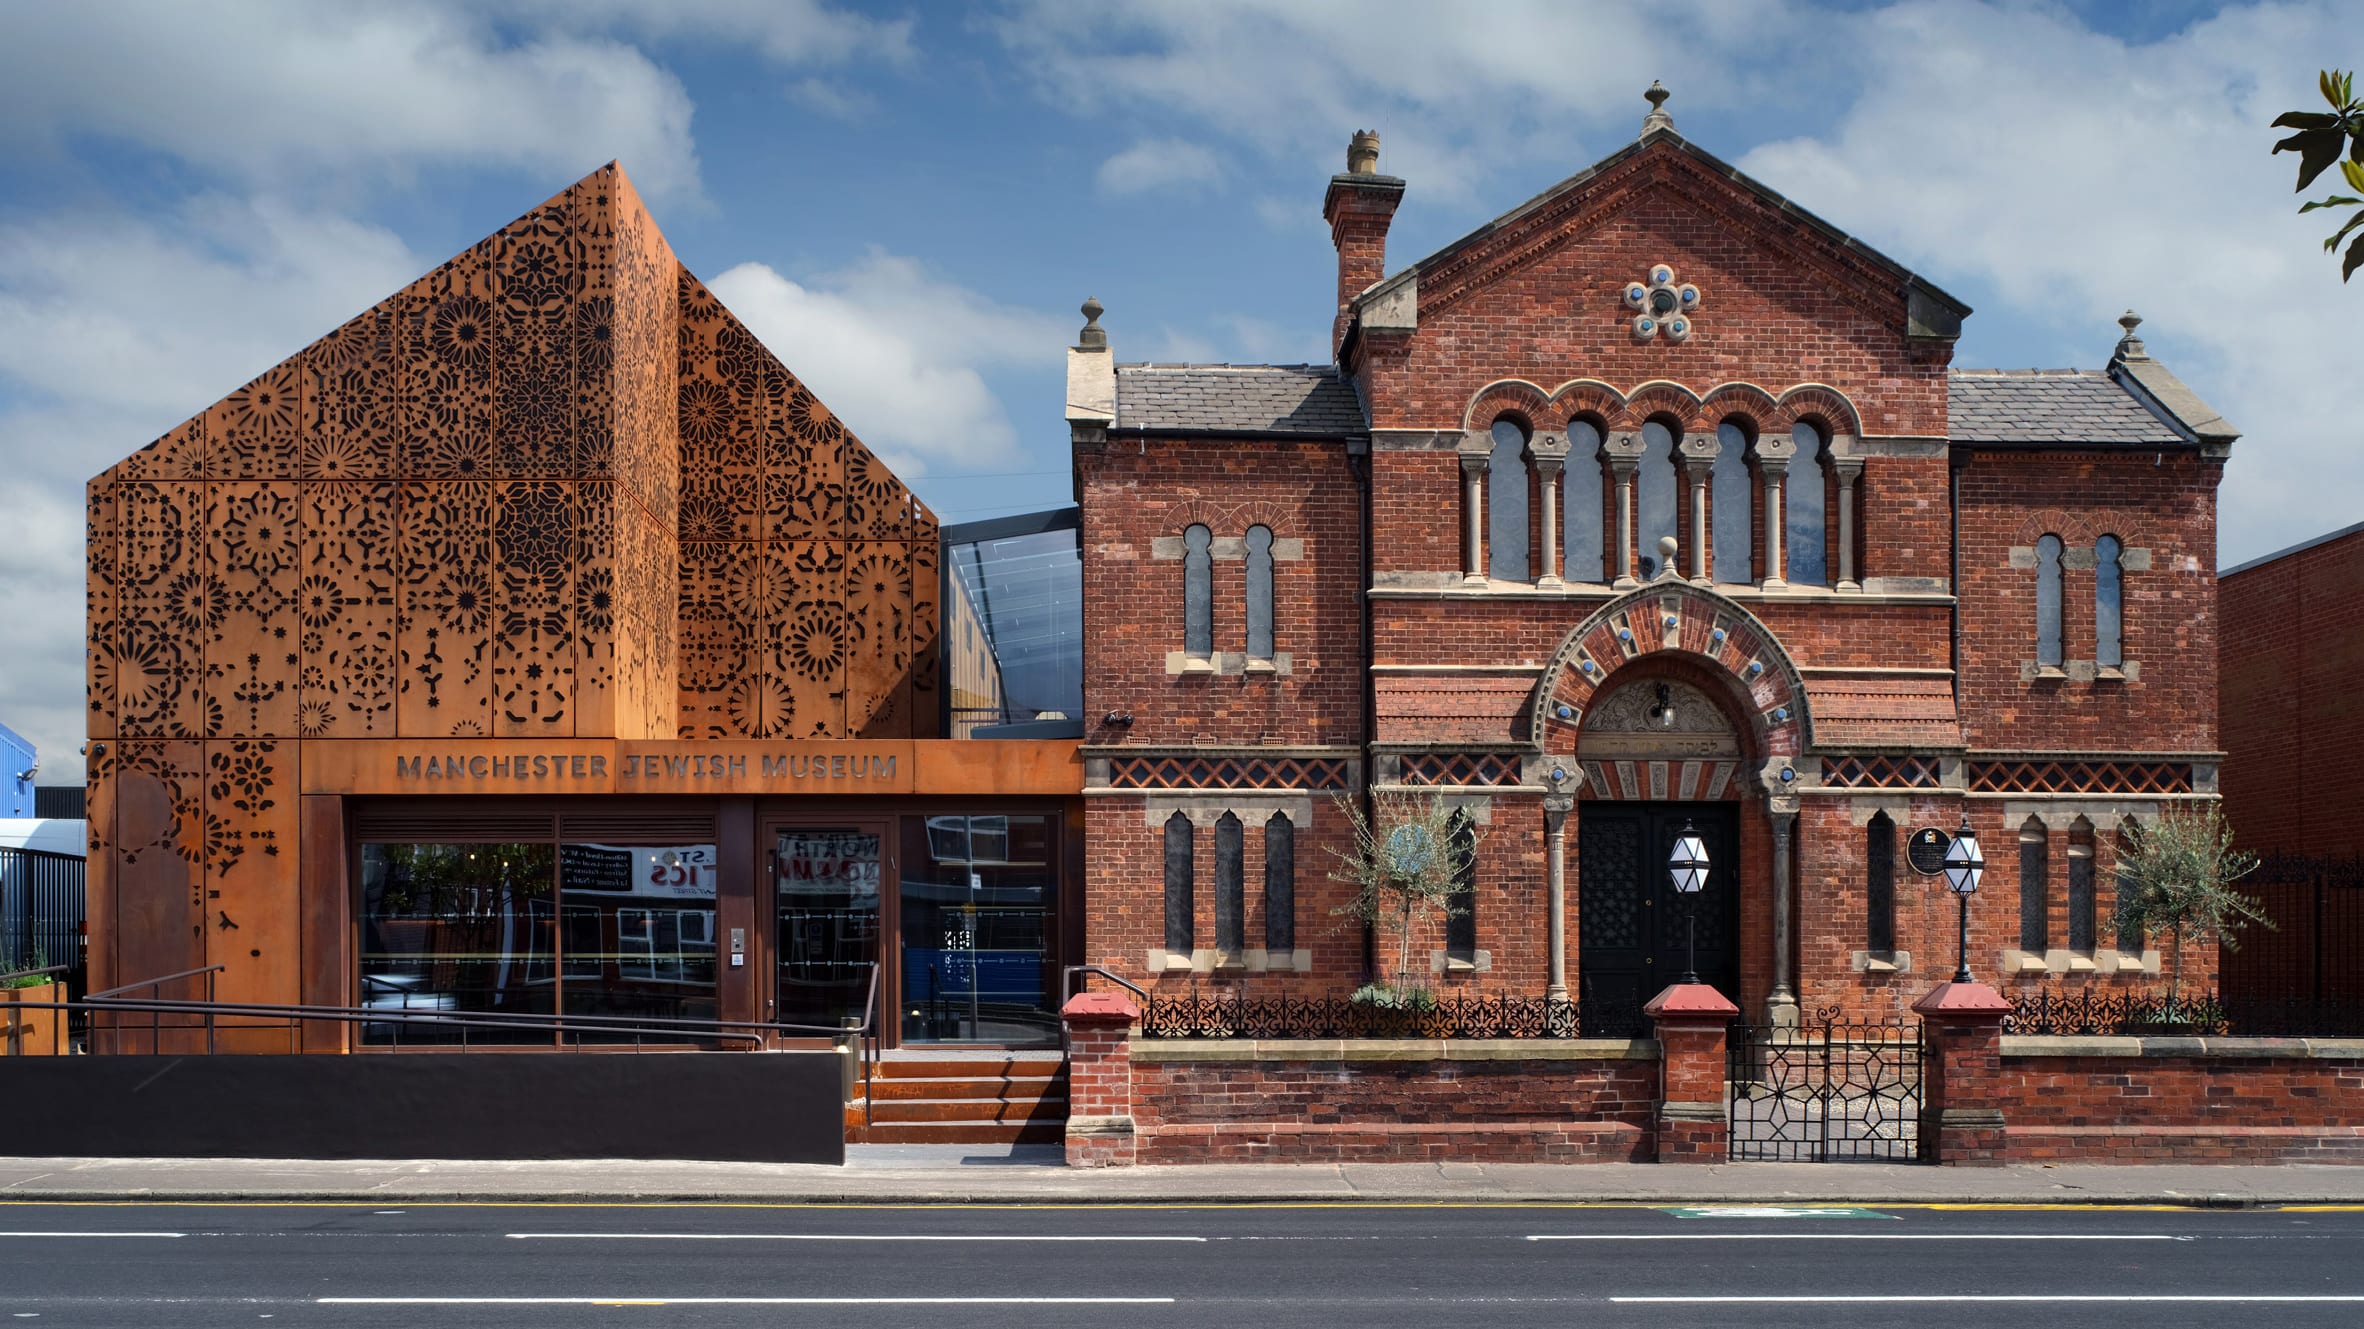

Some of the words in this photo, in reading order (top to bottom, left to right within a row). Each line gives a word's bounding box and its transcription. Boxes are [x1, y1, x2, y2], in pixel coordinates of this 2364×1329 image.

[397, 755, 609, 778] MANCHESTER
[623, 755, 746, 778] JEWISH
[762, 755, 897, 777] MUSEUM
